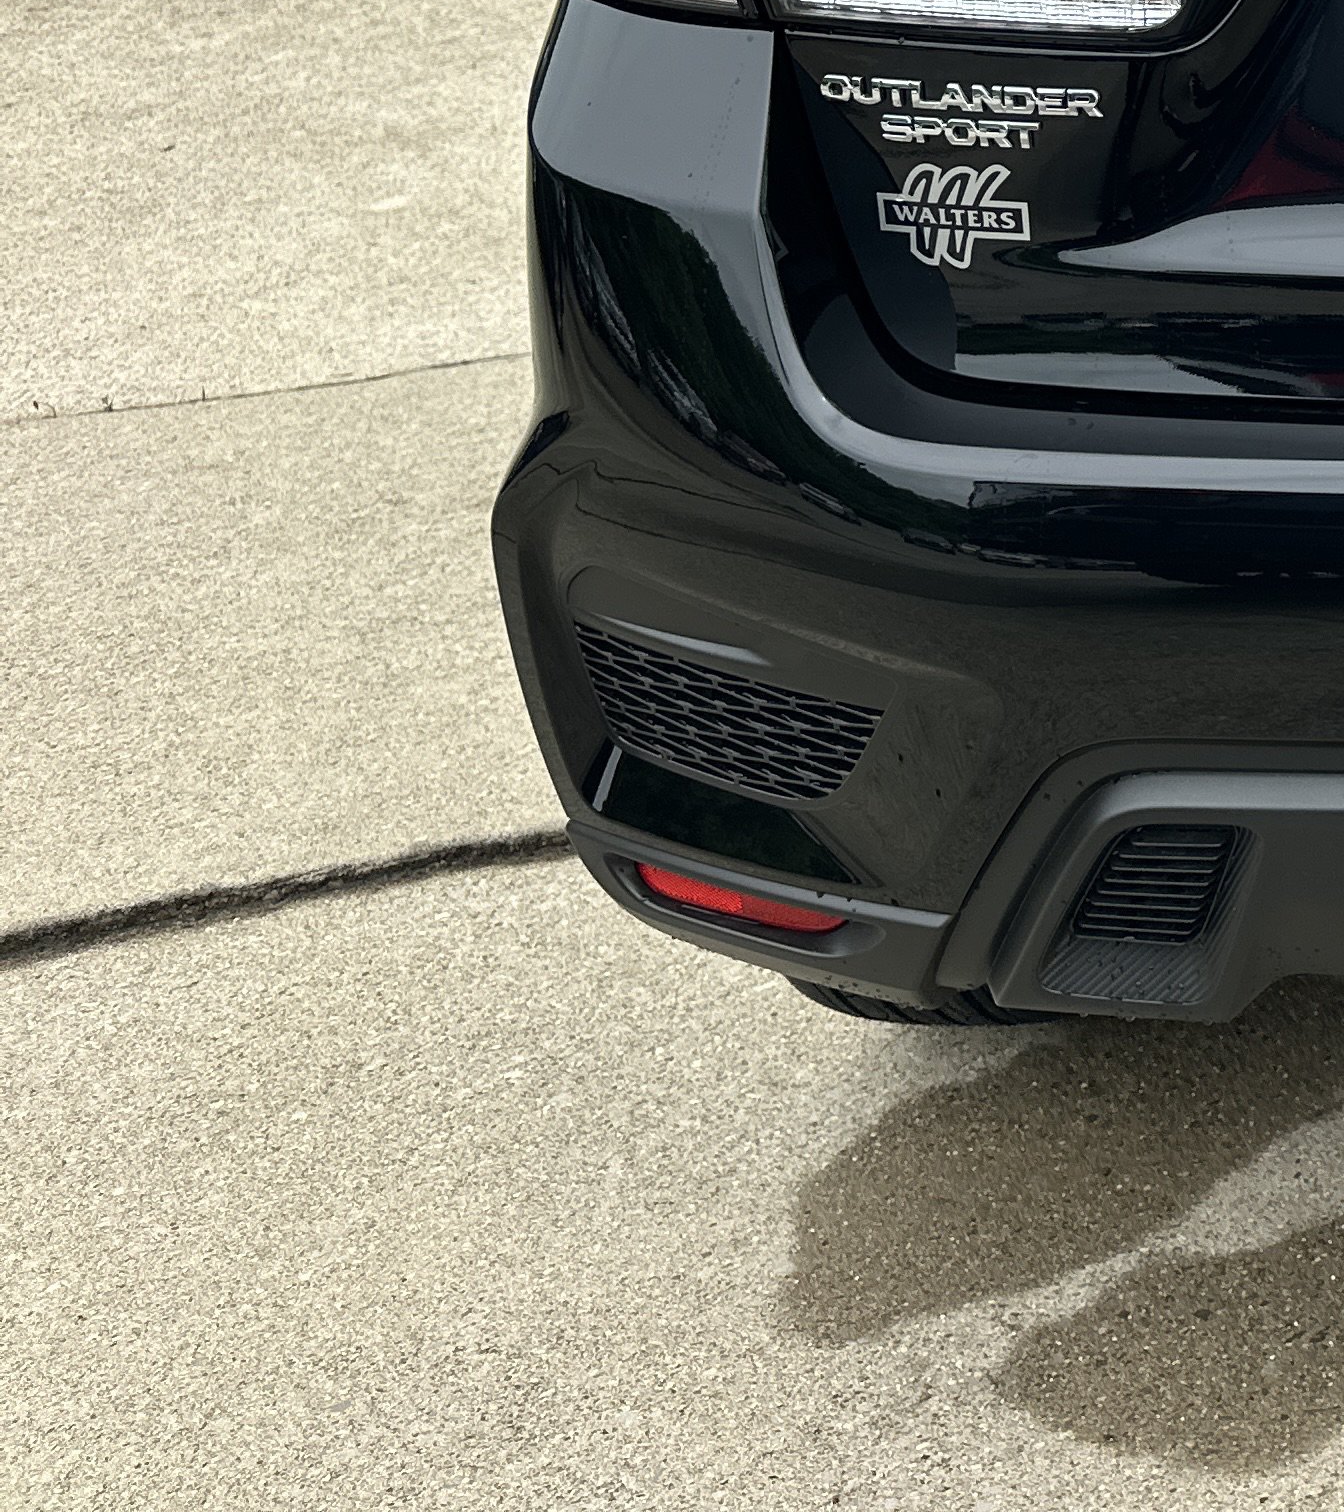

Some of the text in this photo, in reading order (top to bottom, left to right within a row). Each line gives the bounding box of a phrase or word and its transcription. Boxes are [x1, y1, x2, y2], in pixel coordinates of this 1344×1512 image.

[820, 73, 1104, 118] OUTLANDER
[880, 114, 1042, 149] SPORT
[892, 204, 1017, 230] WALTERS
